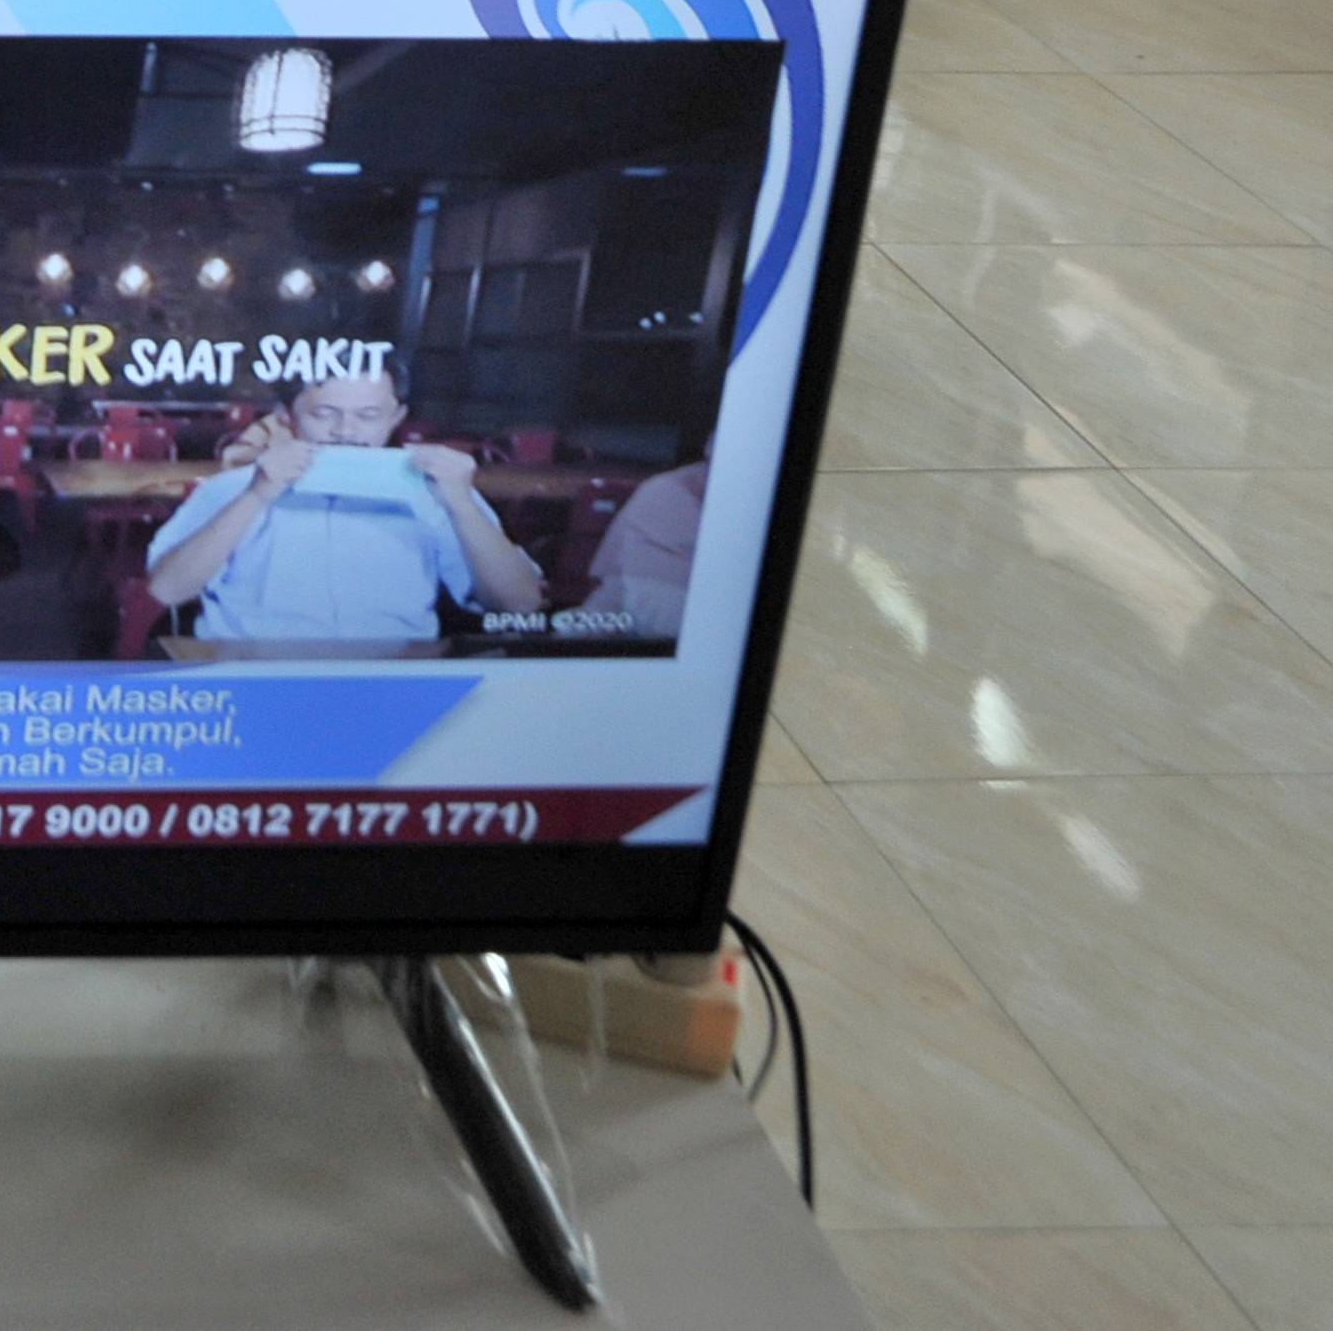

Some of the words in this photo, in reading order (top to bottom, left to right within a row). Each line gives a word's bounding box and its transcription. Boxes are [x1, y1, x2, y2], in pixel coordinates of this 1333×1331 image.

[124, 334, 243, 388] SAAT
[252, 334, 393, 385] SAKIT
[87, 685, 237, 719] Masker,
[25, 715, 242, 752] Berkumpul,
[79, 748, 174, 783] Saja.
[44, 803, 148, 838] 9000
[160, 803, 177, 838] /
[188, 803, 291, 838] 0812
[305, 803, 409, 838] 7177
[420, 801, 539, 842] 1771)
